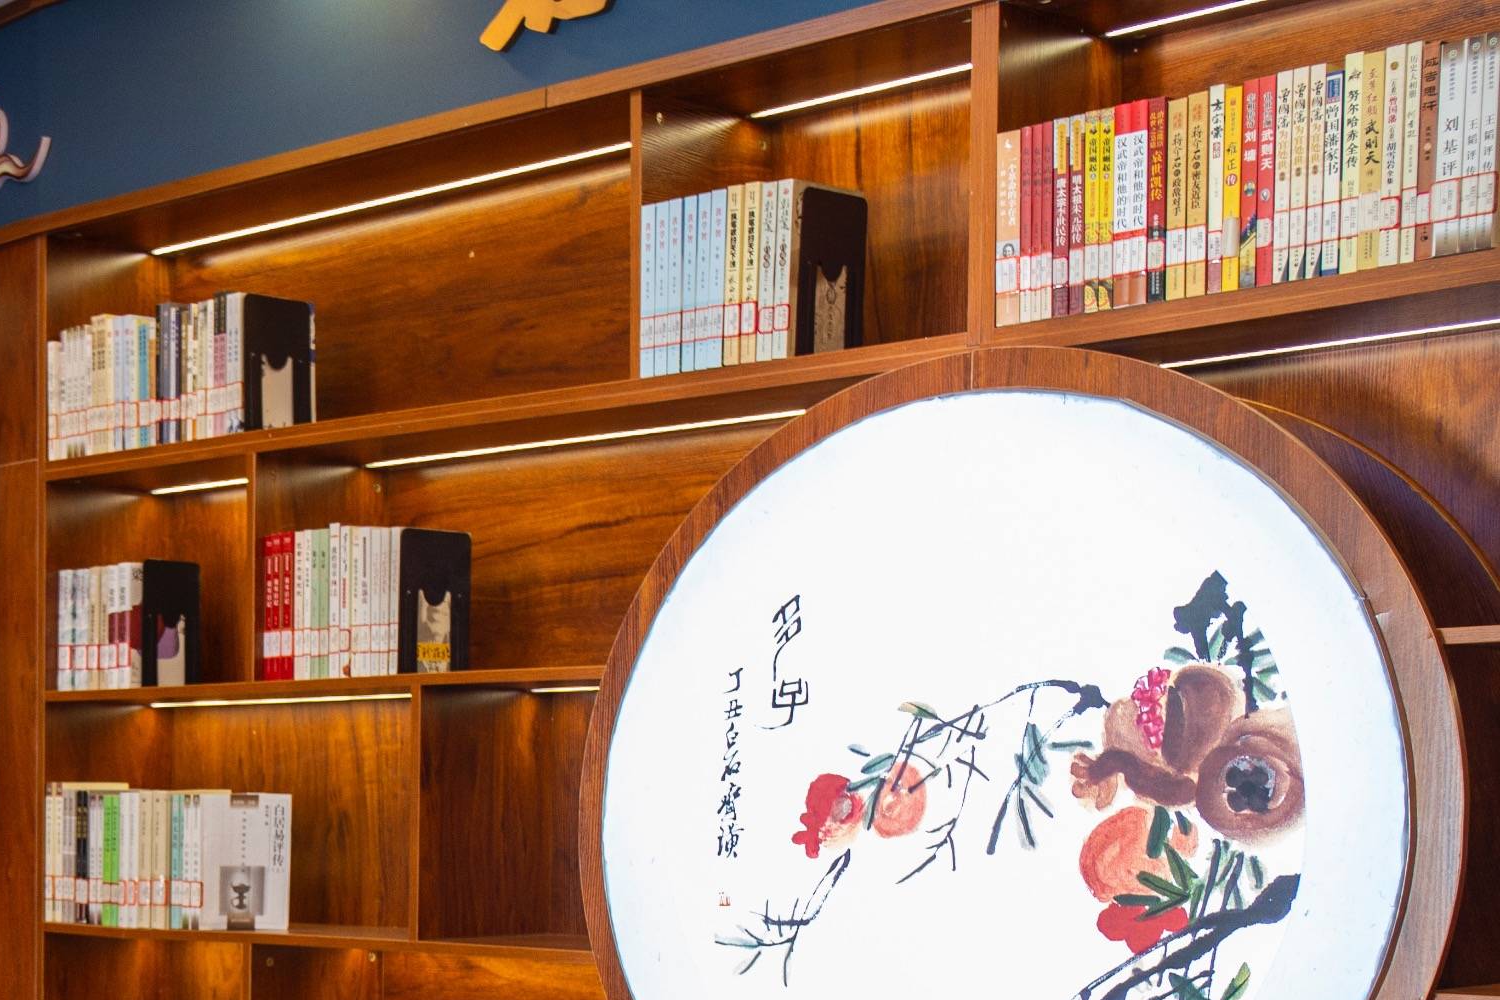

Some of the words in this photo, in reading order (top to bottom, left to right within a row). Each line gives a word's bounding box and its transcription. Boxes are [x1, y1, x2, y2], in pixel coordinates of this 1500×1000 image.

[1422, 57, 1440, 112] 成吉思汗
[1260, 129, 1274, 171] 武则天
[1345, 89, 1360, 169] 努尔哈赤全传
[1364, 118, 1381, 166] 武则天
[1116, 136, 1129, 231] 汉武帝和他的时代
[1132, 134, 1145, 228] 汉武帝和他的时代
